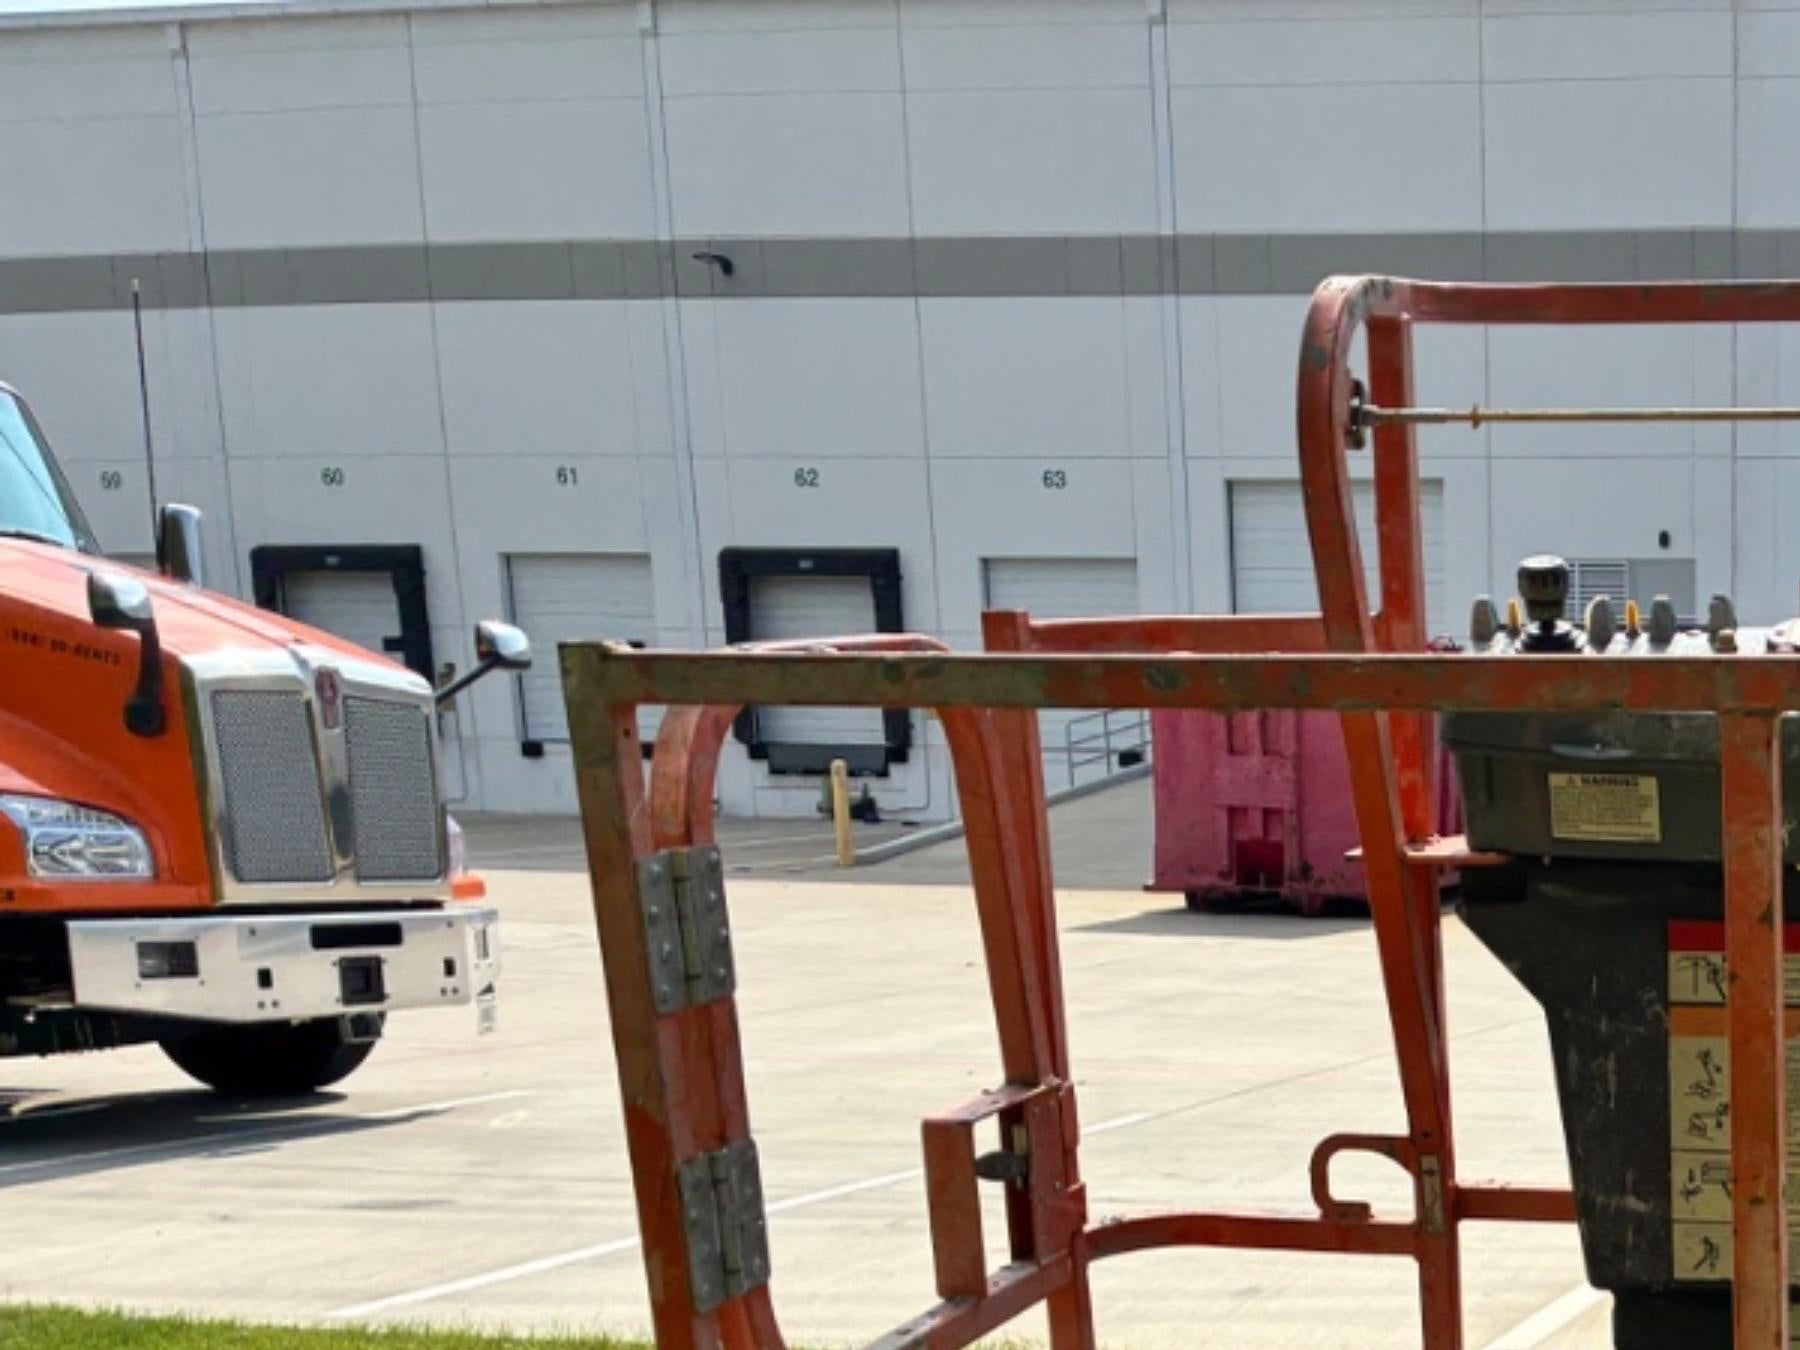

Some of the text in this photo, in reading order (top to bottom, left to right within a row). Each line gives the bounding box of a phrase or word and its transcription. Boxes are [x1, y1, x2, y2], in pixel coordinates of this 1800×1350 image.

[557, 467, 577, 487] 61
[795, 467, 820, 487] 62
[1043, 470, 1067, 490] 63
